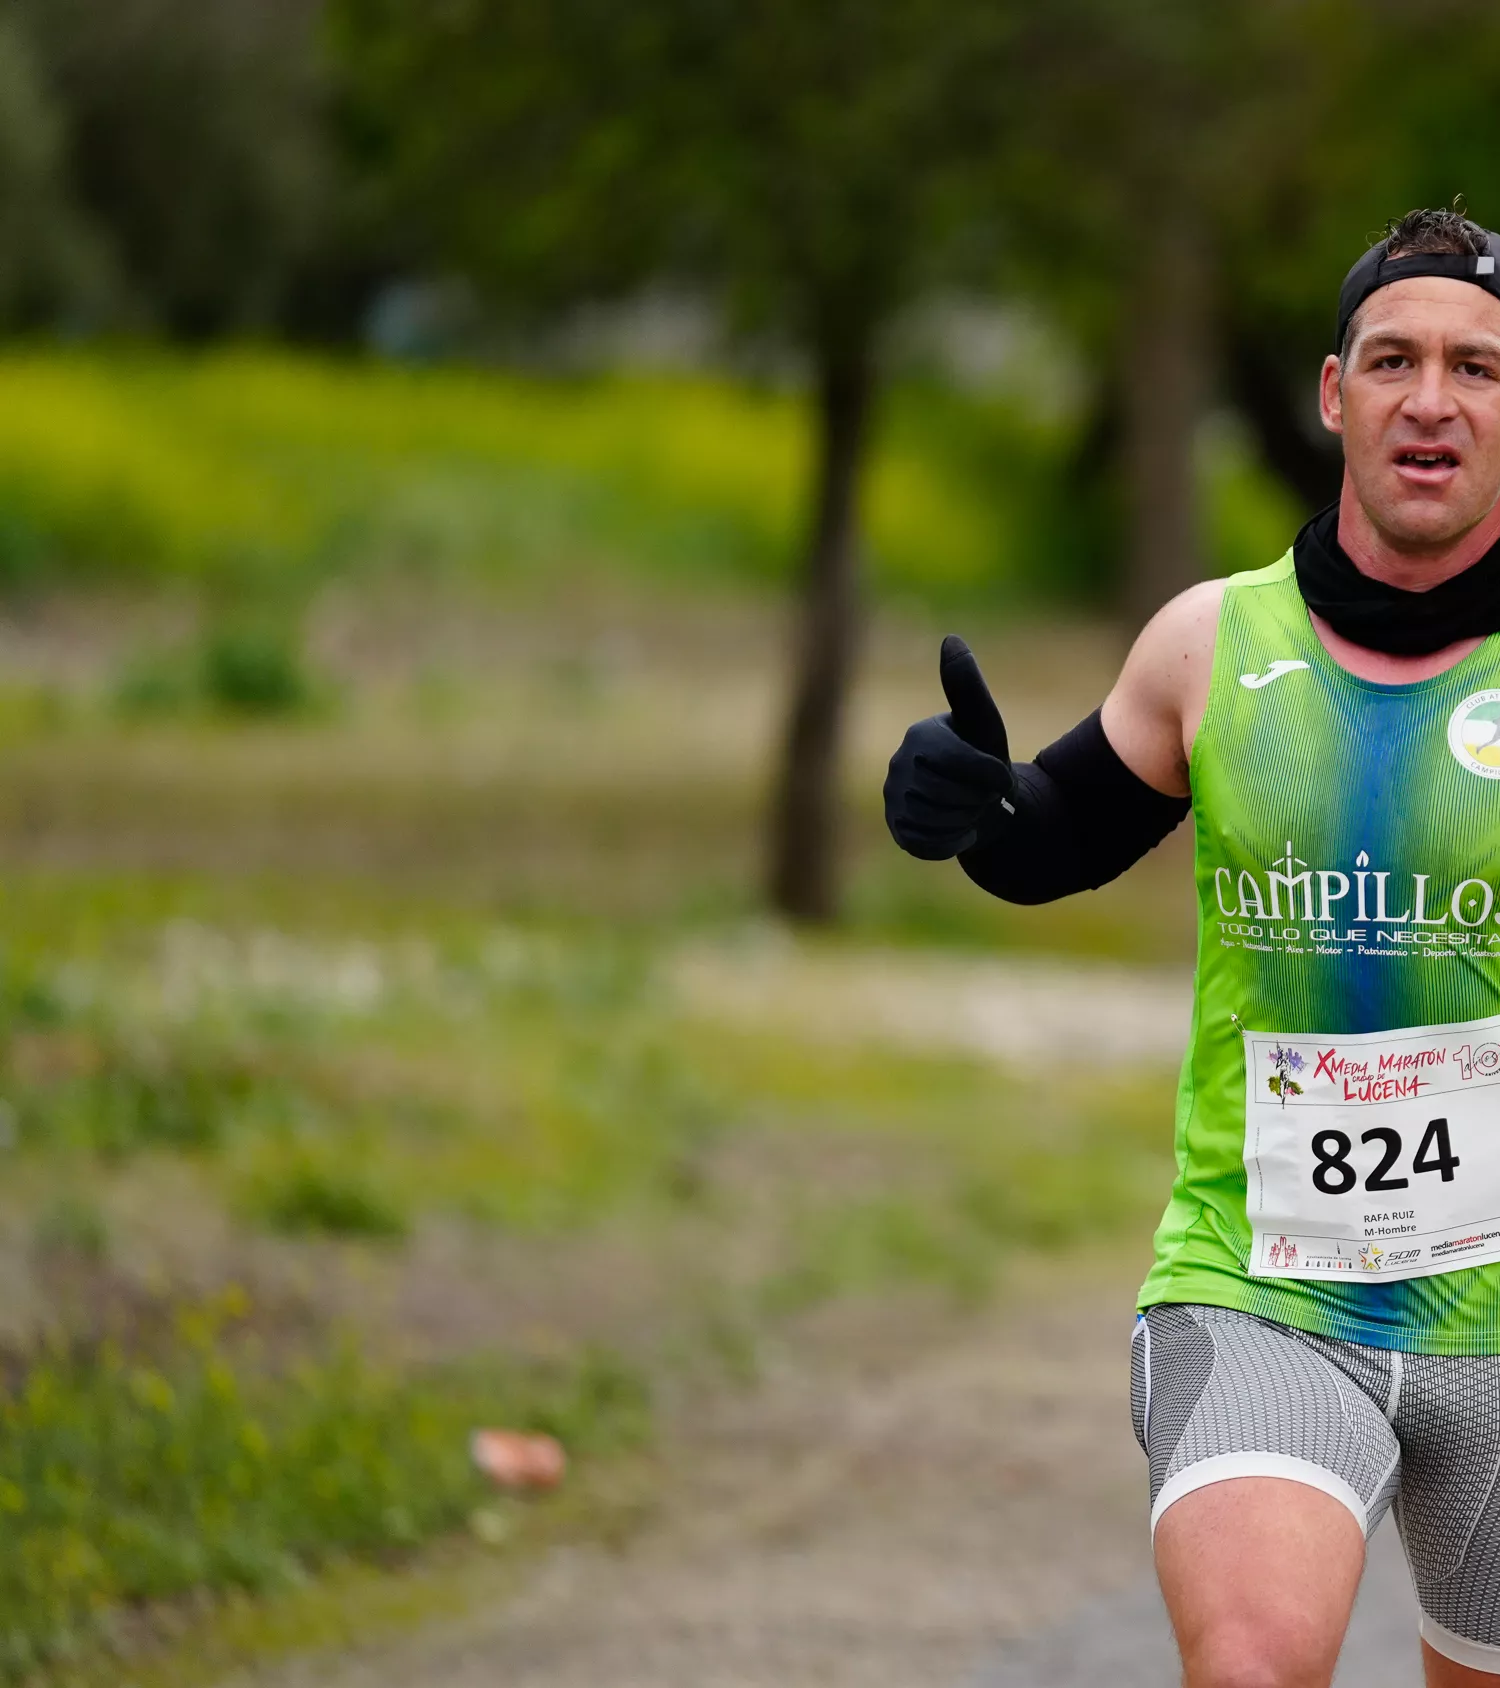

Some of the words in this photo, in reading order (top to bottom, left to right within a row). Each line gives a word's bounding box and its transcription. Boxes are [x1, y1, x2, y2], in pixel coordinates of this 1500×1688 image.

[1466, 695, 1486, 709] CLUB
[1217, 921, 1263, 937] TODO
[1269, 927, 1300, 940] LO
[1310, 928, 1367, 941] QUE
[1315, 945, 1343, 955] Motor
[1358, 945, 1408, 957] Patrimonio
[1423, 947, 1457, 960] Deporte
[1344, 1075, 1433, 1103] LUCENA
[1311, 1117, 1460, 1195] 824
[1363, 1213, 1390, 1223] RAFA
[1392, 1210, 1415, 1220] RUIZ
[1364, 1224, 1417, 1237] M-Hombre
